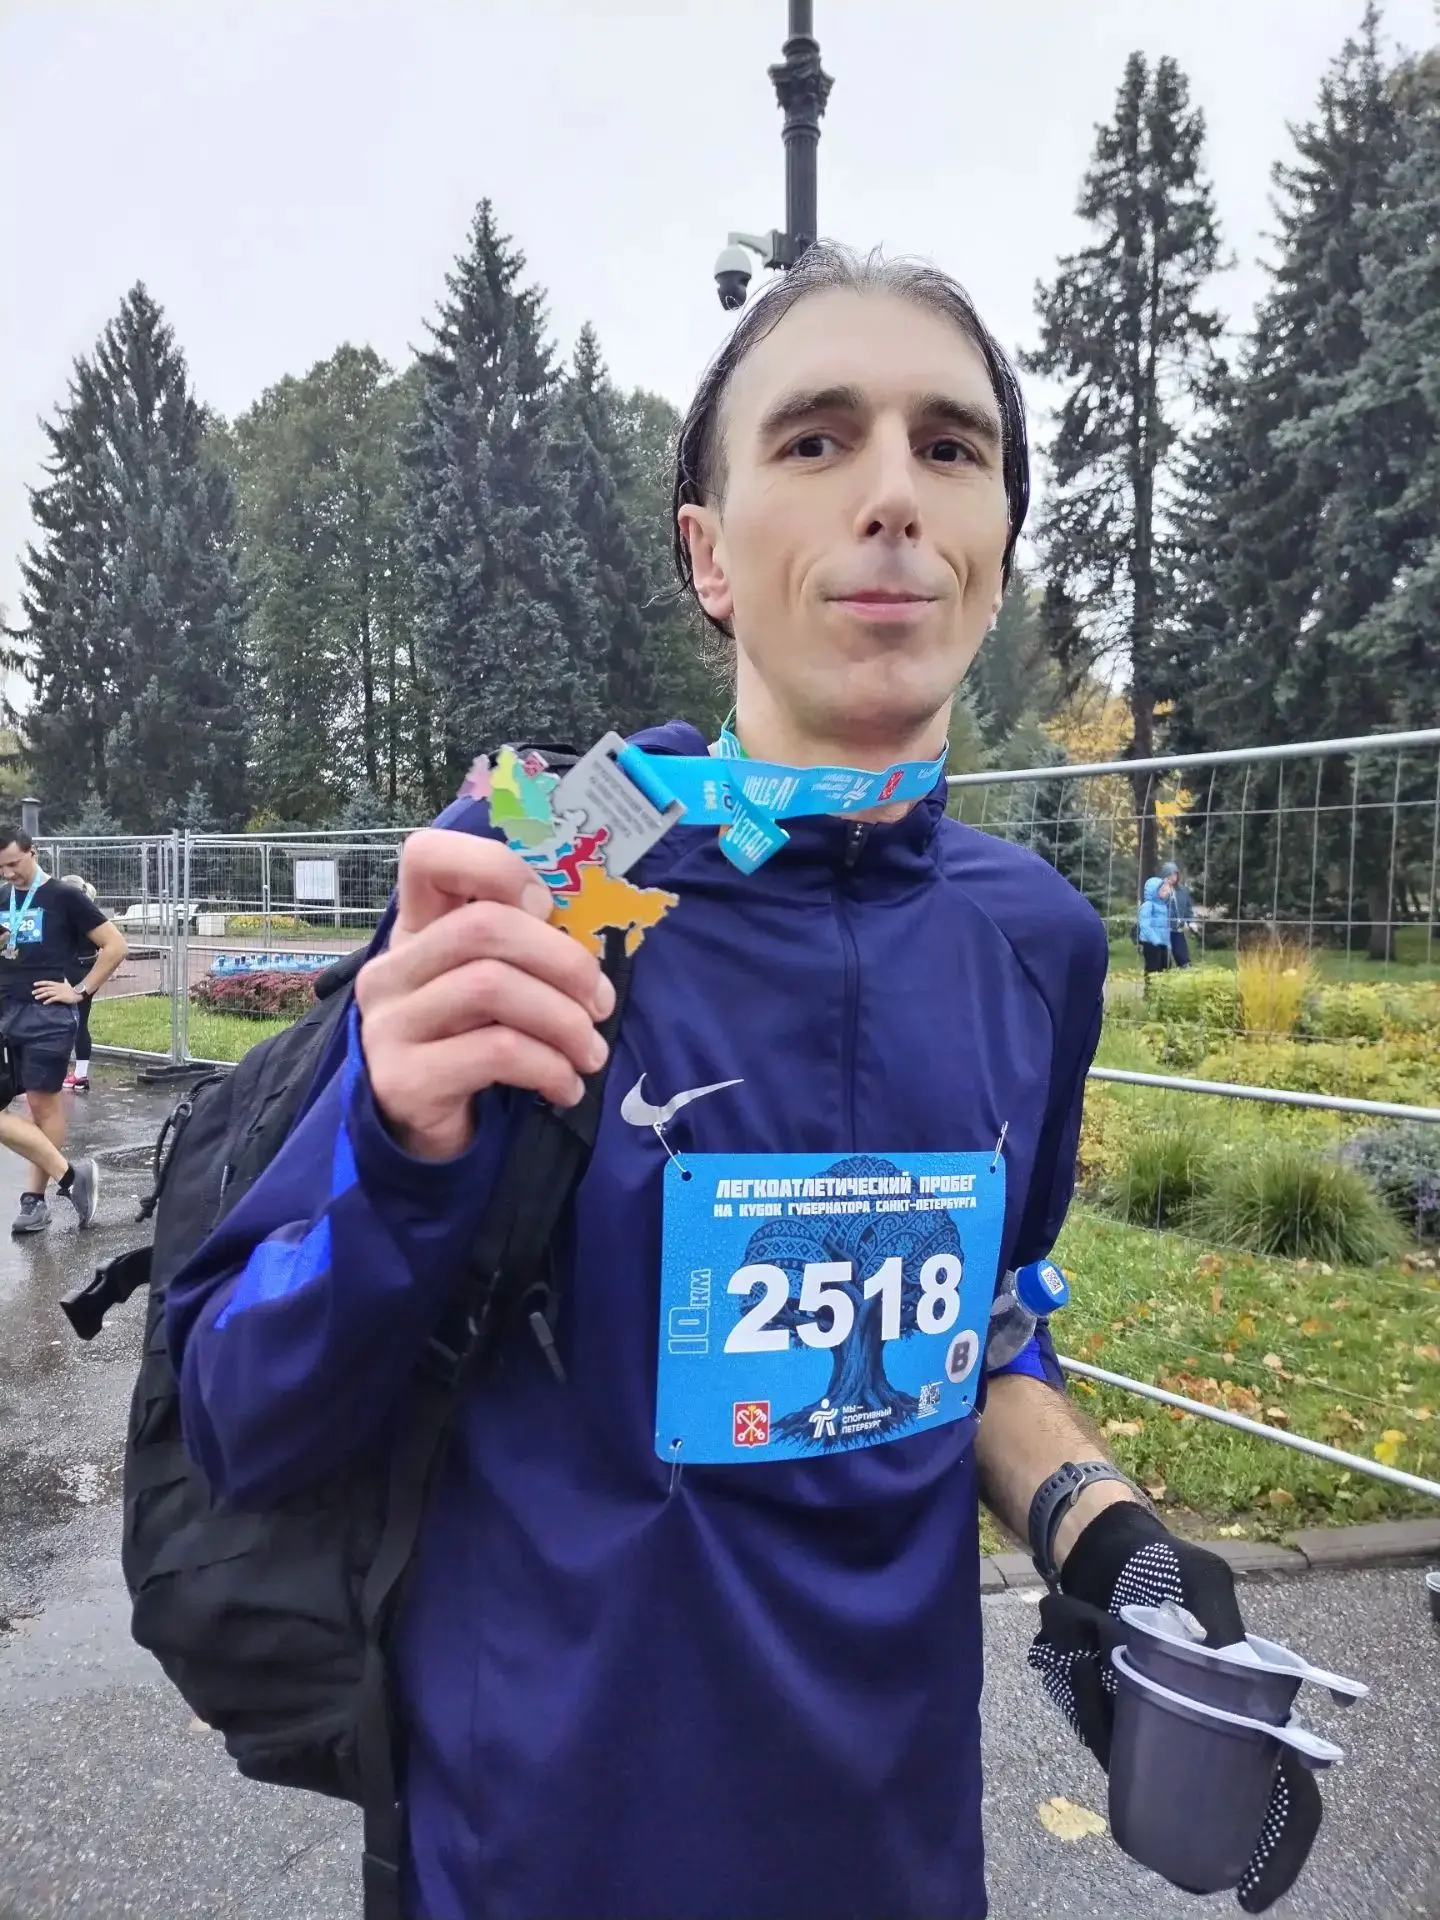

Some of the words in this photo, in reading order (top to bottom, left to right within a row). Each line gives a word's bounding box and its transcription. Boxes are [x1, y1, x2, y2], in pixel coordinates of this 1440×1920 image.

[715, 1172, 912, 1199] ЛЕГКОАТЛЕТИЧЕСКИЙ
[919, 1174, 977, 1193] ПРОБЕГ
[713, 1203, 733, 1218] НА
[739, 1202, 782, 1217] КУБОК
[787, 1200, 871, 1216] ГУБЕРНАТОРА
[875, 1196, 977, 1213] САНКТ-ПЕТЕРБУРГА
[723, 1253, 963, 1354] 2518
[668, 1306, 709, 1354] 10
[841, 1419, 882, 1434] ПЕТЕРБУРГ
[842, 1407, 892, 1424] СПОРТИВНЫЙ
